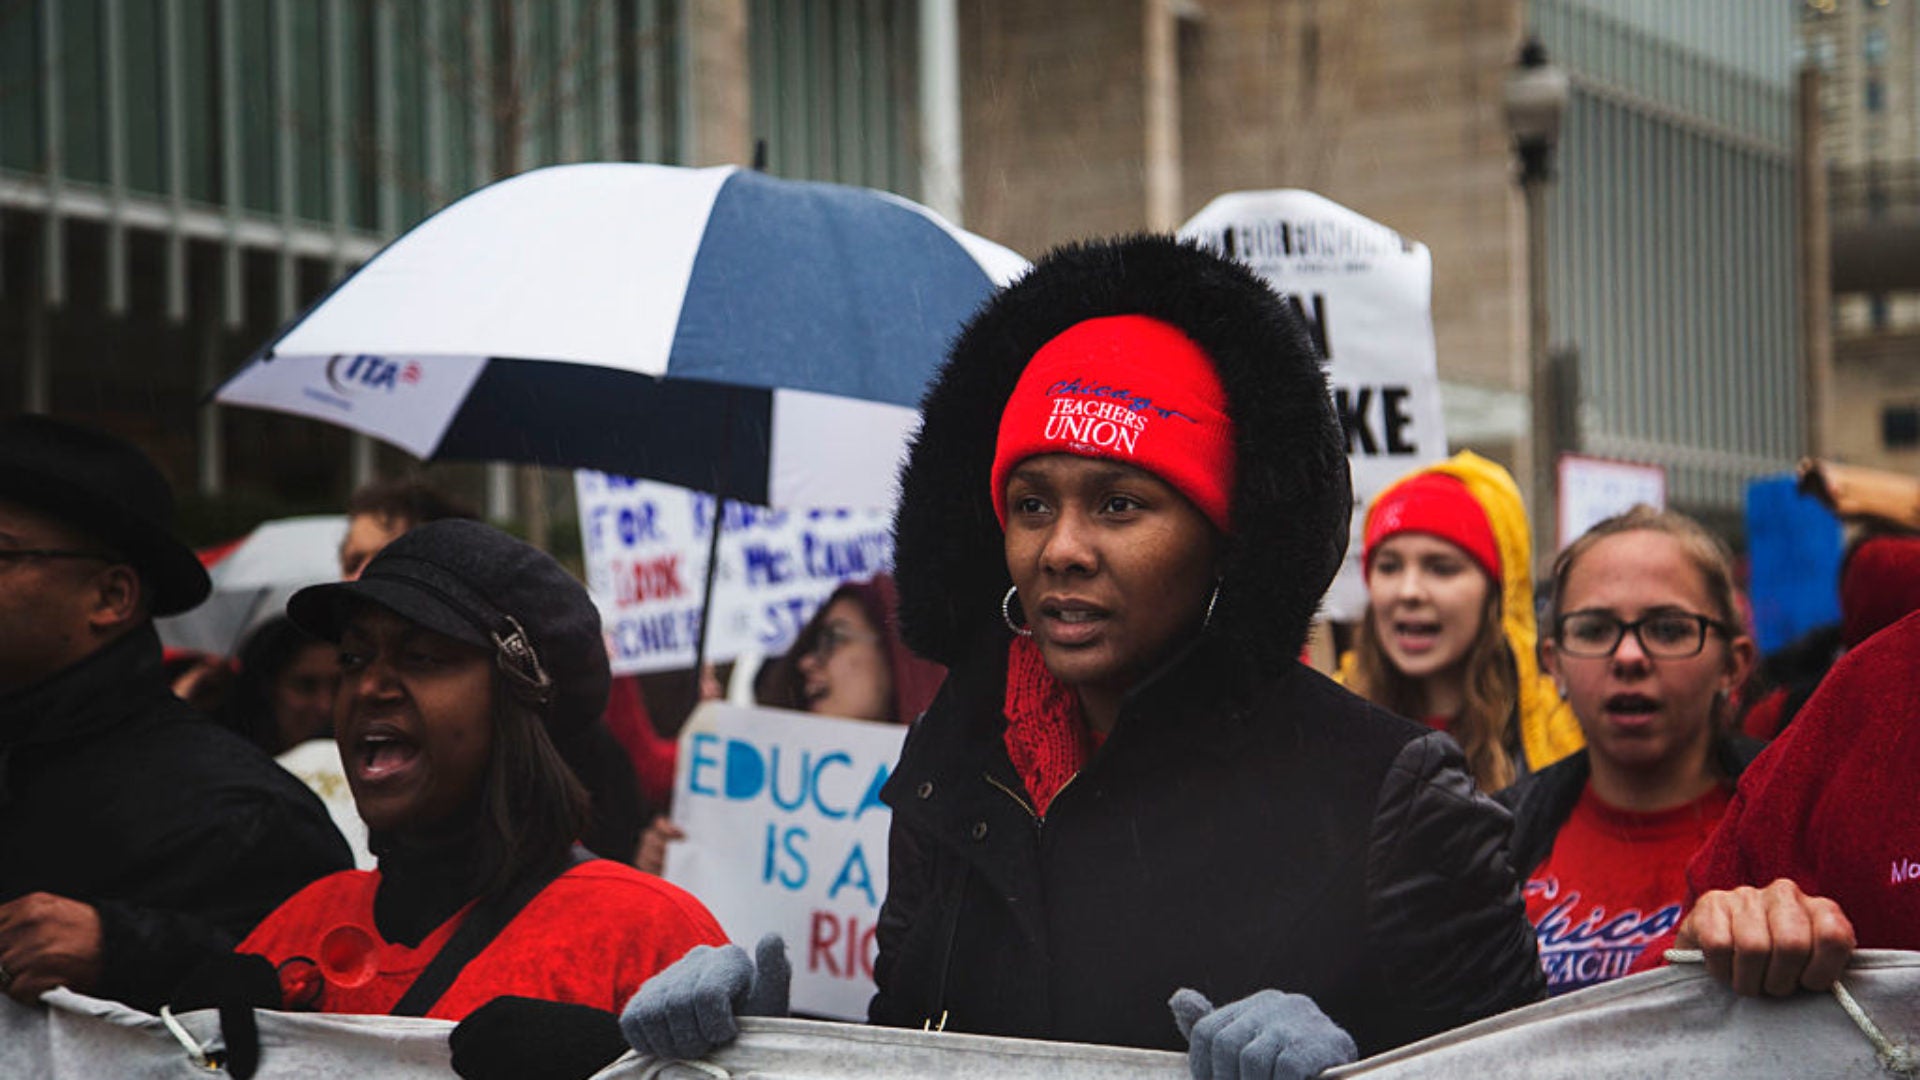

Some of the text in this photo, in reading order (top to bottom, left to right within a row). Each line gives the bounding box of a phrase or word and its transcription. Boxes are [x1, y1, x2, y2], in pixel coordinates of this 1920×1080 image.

[1044, 414, 1139, 454] UNION
[1052, 397, 1148, 431] TEACHERS
[762, 822, 877, 905] IS A
